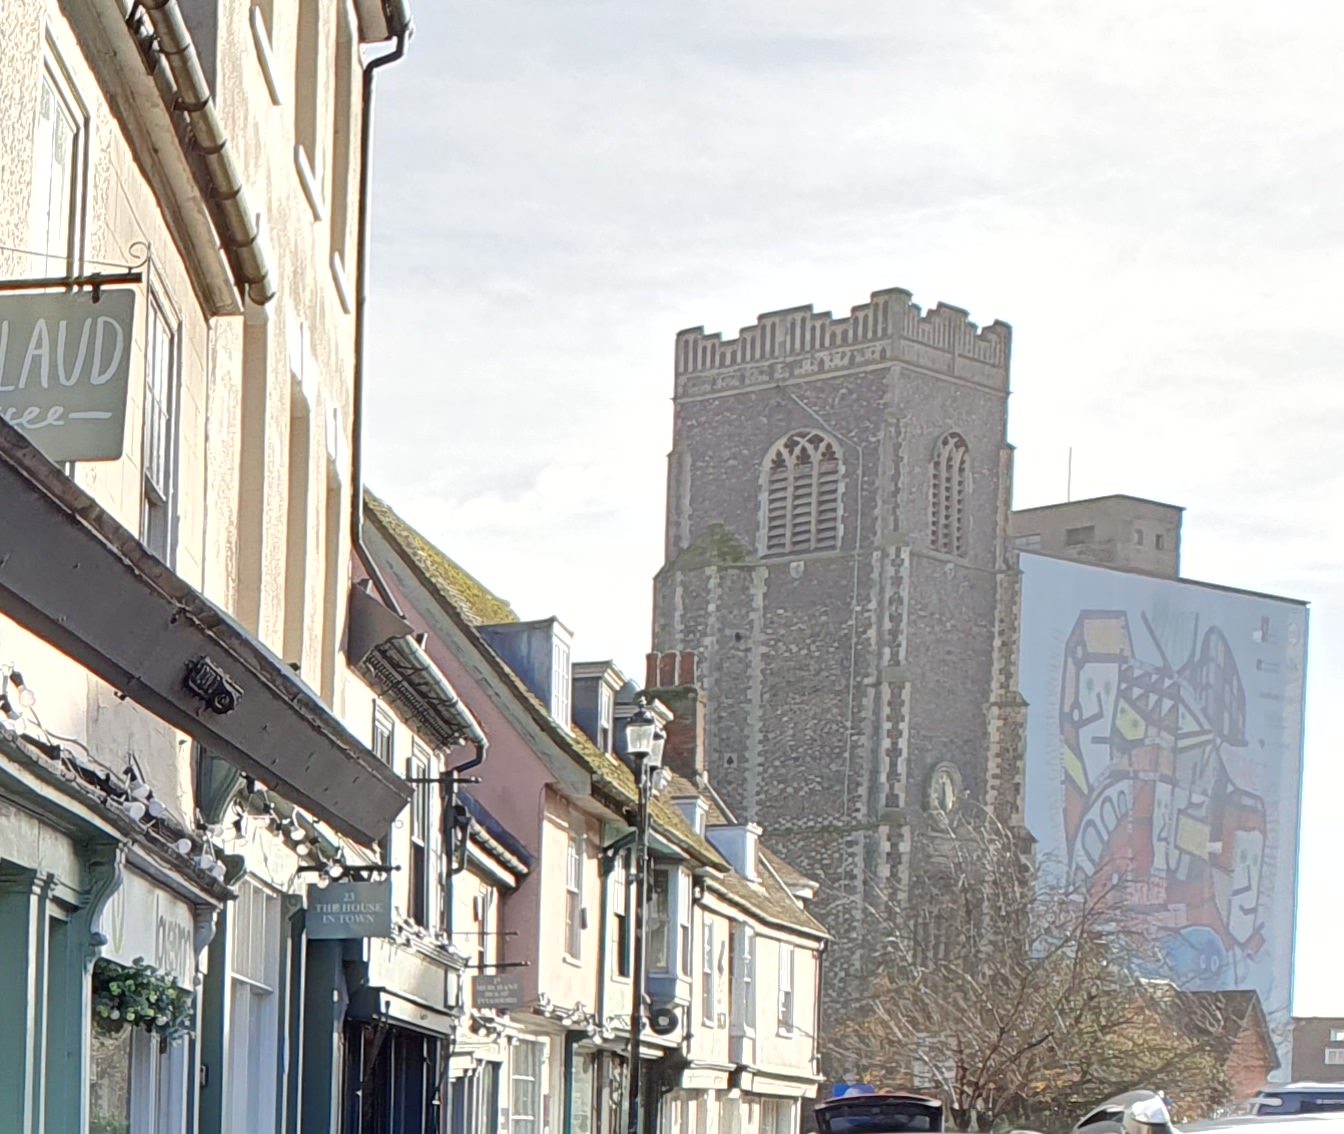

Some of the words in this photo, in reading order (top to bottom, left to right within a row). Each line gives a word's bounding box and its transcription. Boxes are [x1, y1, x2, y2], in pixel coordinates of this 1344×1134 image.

[315, 903, 340, 913] THE
[342, 903, 383, 913] HOUSE
[322, 914, 336, 924] IN
[339, 914, 375, 924] TOWN
